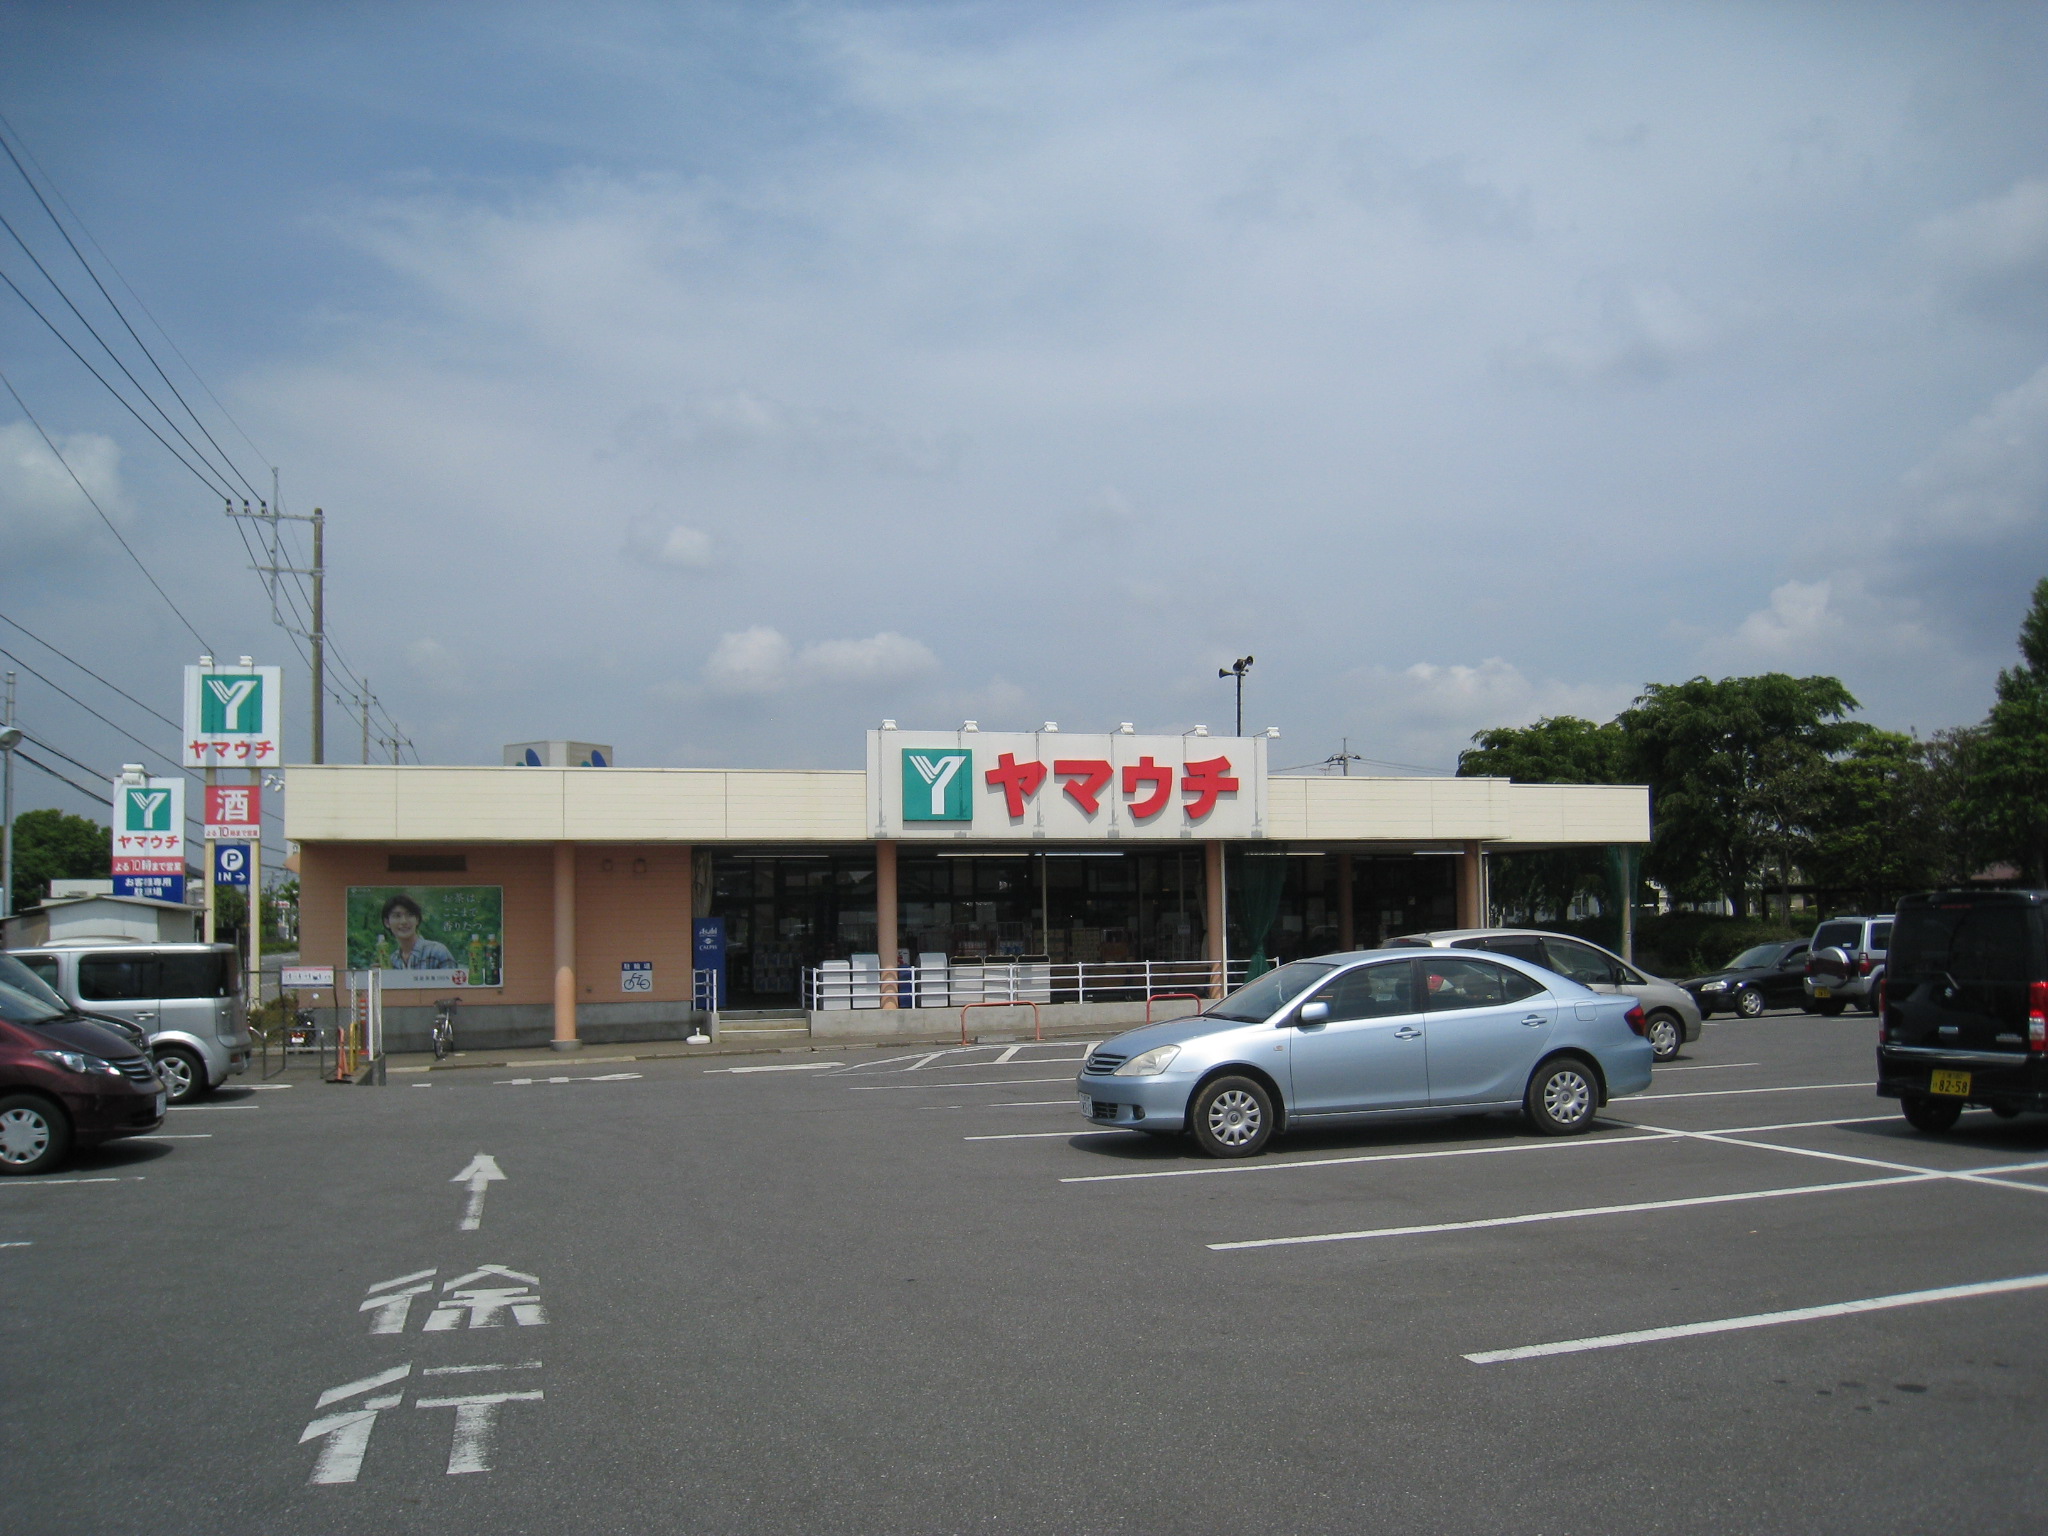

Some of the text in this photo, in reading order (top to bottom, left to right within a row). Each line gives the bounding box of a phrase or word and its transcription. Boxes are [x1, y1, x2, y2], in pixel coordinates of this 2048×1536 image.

[189, 740, 275, 760] ヤマウチ
[985, 752, 1239, 820] ヤマウチ
[216, 789, 250, 822] 酒
[117, 835, 180, 849] ヤマウチ
[115, 859, 182, 872] よる10時まで営業
[226, 853, 239, 867] P
[217, 872, 232, 882] IN
[1938, 1079, 1968, 1093] 82-58
